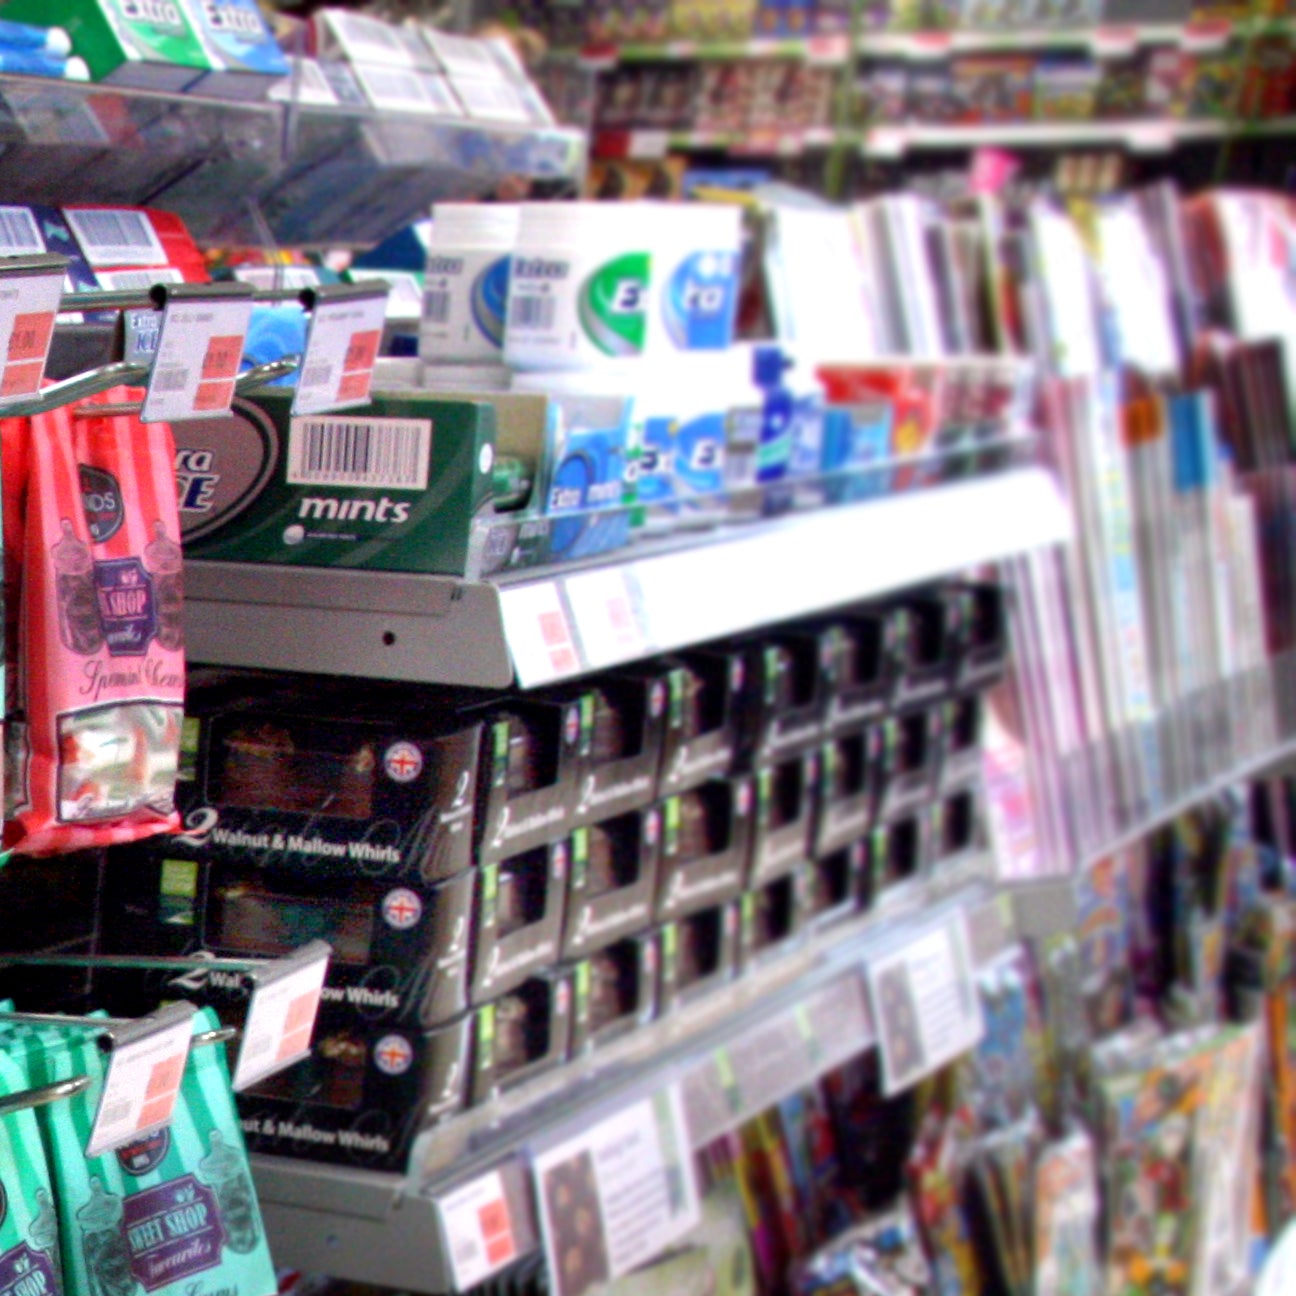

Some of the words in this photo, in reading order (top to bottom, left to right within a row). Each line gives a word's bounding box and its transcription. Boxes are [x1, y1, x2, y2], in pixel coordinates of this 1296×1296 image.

[297, 496, 412, 524] mints
[171, 807, 219, 846] 2
[213, 828, 268, 849] Walnut
[272, 833, 285, 852] &
[288, 835, 346, 858] Mallow
[349, 842, 401, 864] Whirls
[345, 988, 400, 1008] Whirls
[264, 1119, 276, 1135] &
[278, 1123, 335, 1145] Mallow
[338, 1130, 391, 1152] Whirls
[164, 1202, 208, 1236] SHOP
